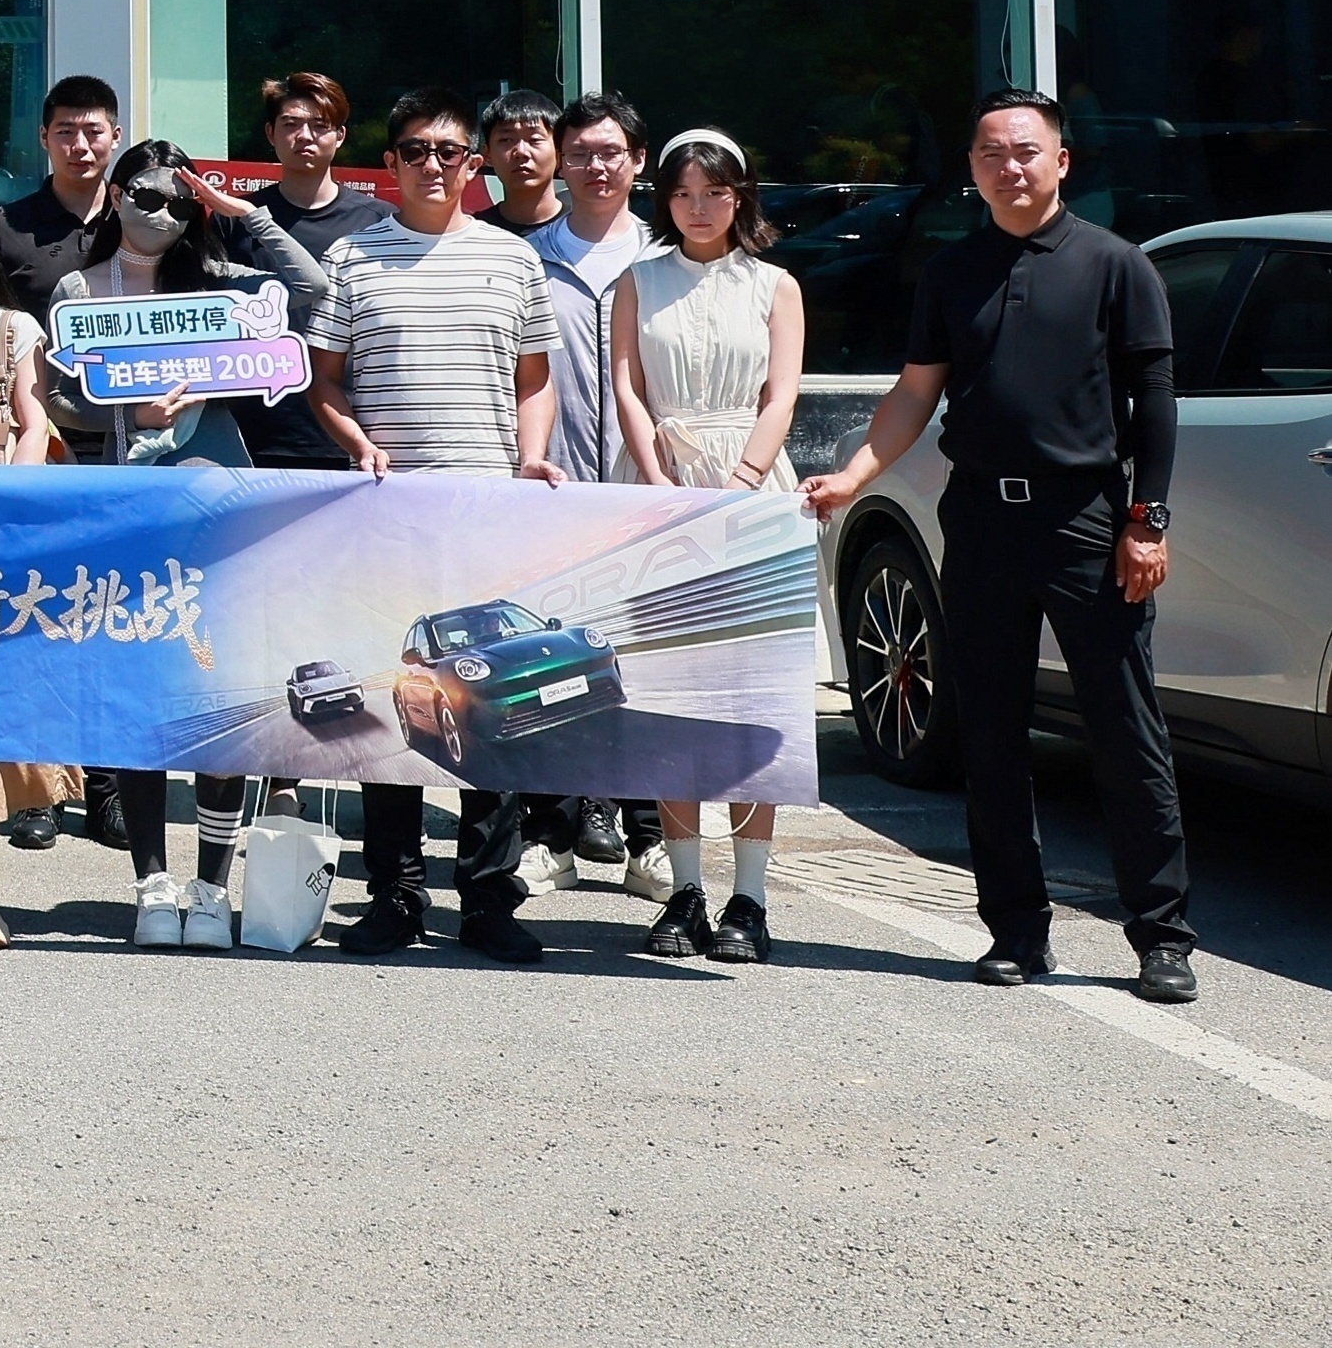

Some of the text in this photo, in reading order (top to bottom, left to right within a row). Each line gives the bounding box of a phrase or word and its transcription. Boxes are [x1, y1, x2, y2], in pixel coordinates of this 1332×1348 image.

[70, 307, 227, 339] 到哪儿都好停
